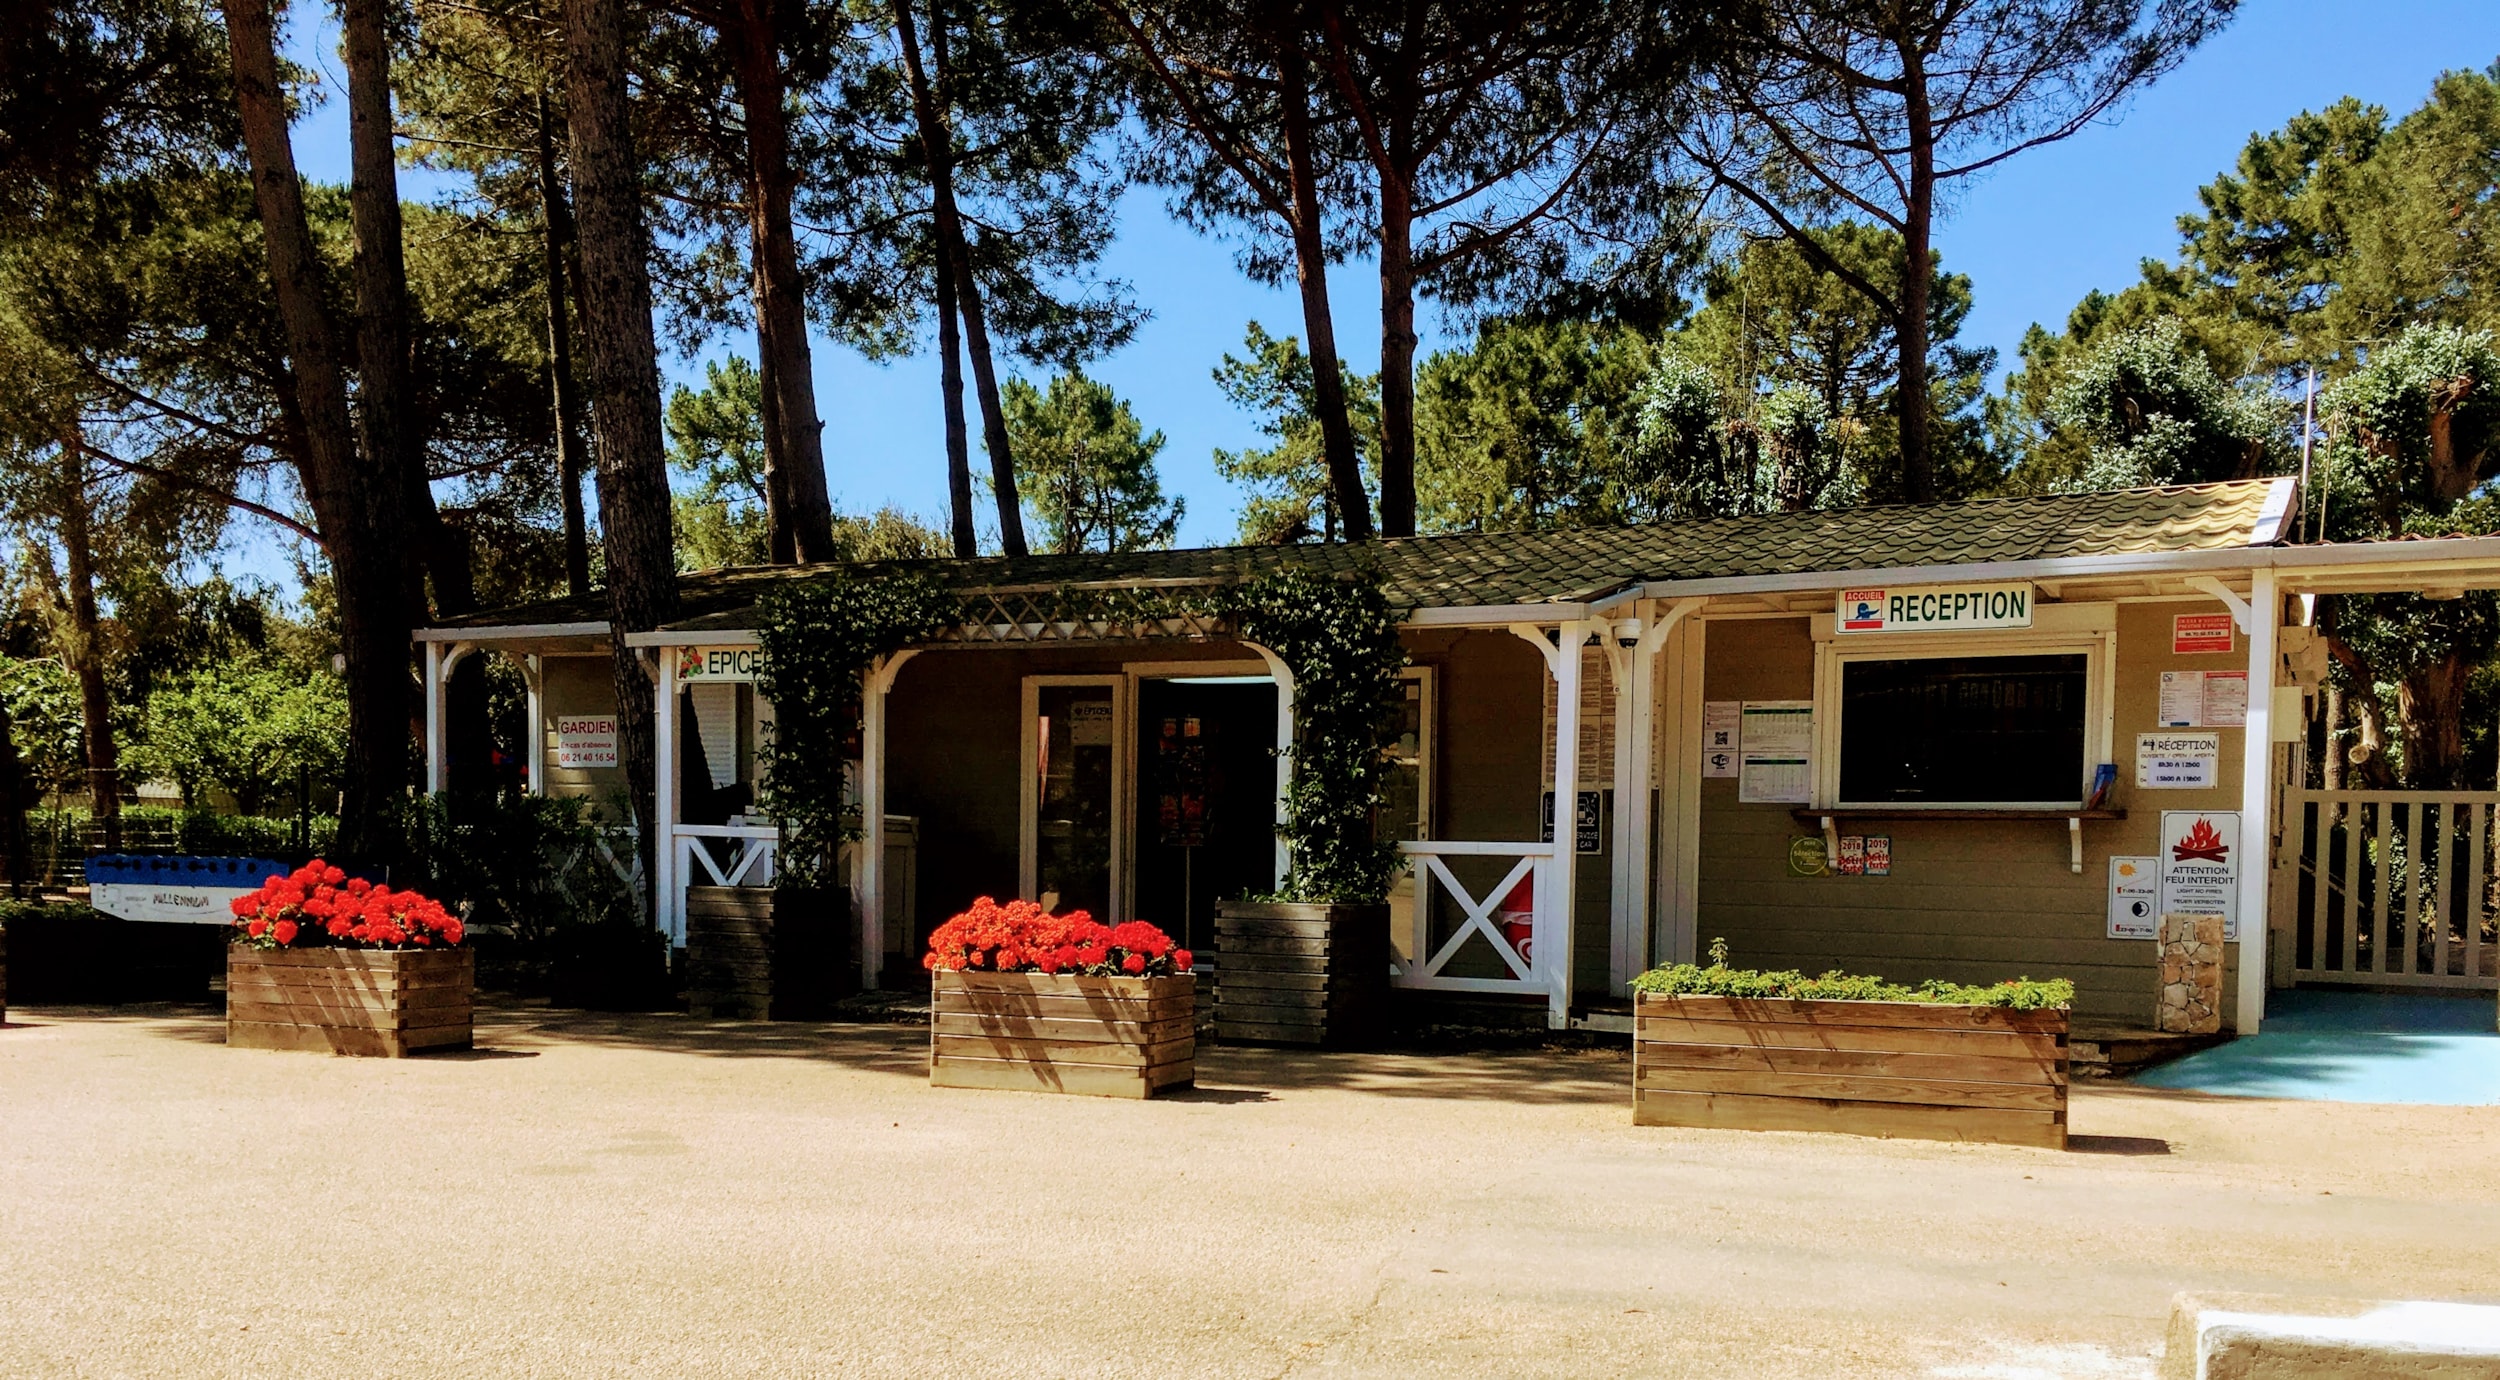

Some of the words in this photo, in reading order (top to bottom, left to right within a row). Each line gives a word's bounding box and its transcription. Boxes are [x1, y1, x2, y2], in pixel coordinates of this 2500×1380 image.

[1846, 591, 1884, 601] ACCUEIL
[1889, 590, 2026, 622] RECEPTION
[708, 650, 768, 674] EPICE
[560, 721, 615, 734] GARDIEN
[2158, 736, 2216, 750] RÉCEPTION
[561, 753, 570, 762] 06
[572, 753, 581, 762] 21
[583, 753, 593, 762] 40
[606, 753, 615, 762] 54
[1842, 842, 1861, 850] 2018
[1868, 839, 1888, 848] 2019
[2172, 866, 2229, 875] ATTENTION
[2165, 876, 2185, 884] FEU
[2187, 876, 2235, 885] INTERDIT
